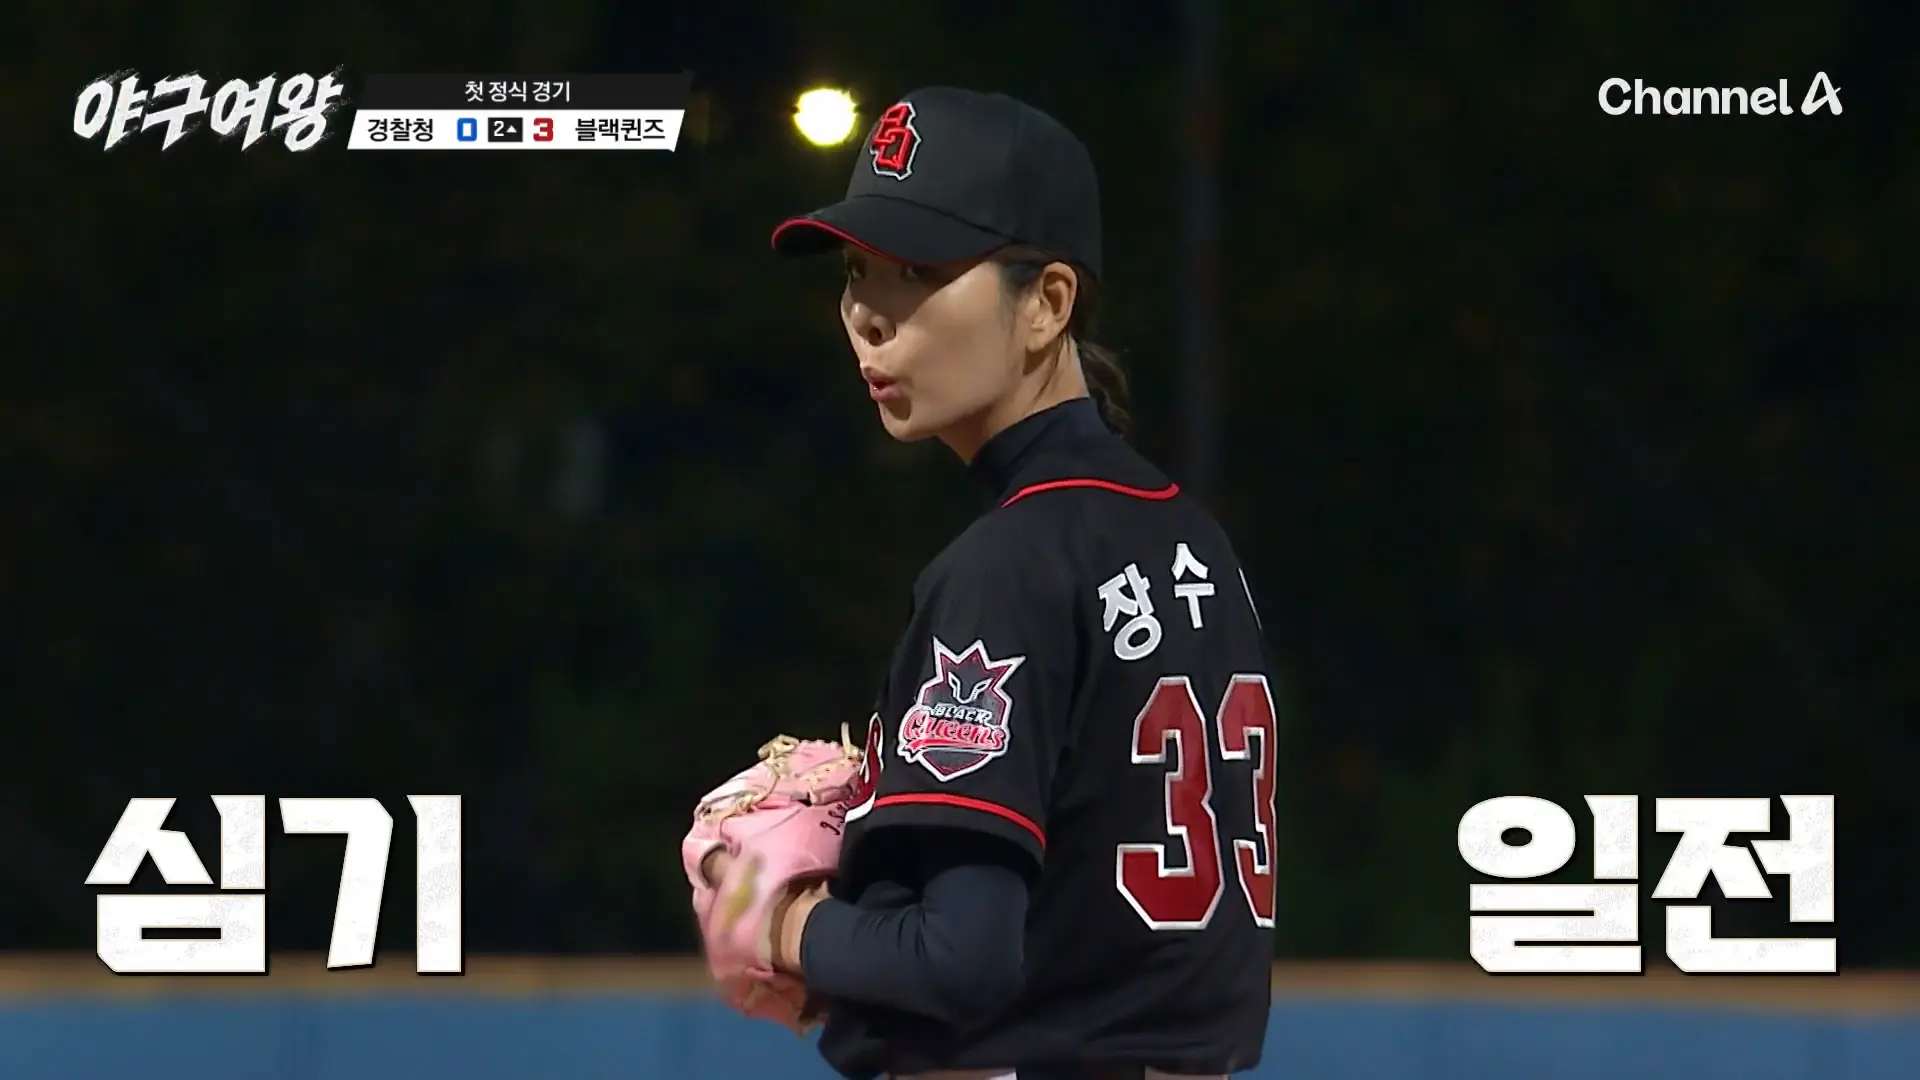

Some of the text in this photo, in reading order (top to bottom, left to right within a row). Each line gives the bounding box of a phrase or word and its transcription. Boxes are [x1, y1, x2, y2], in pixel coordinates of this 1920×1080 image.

[1097, 542, 1263, 661] 장수
[903, 708, 1007, 747] Queens
[933, 703, 993, 724] BLACK
[1116, 674, 1278, 931] 33
